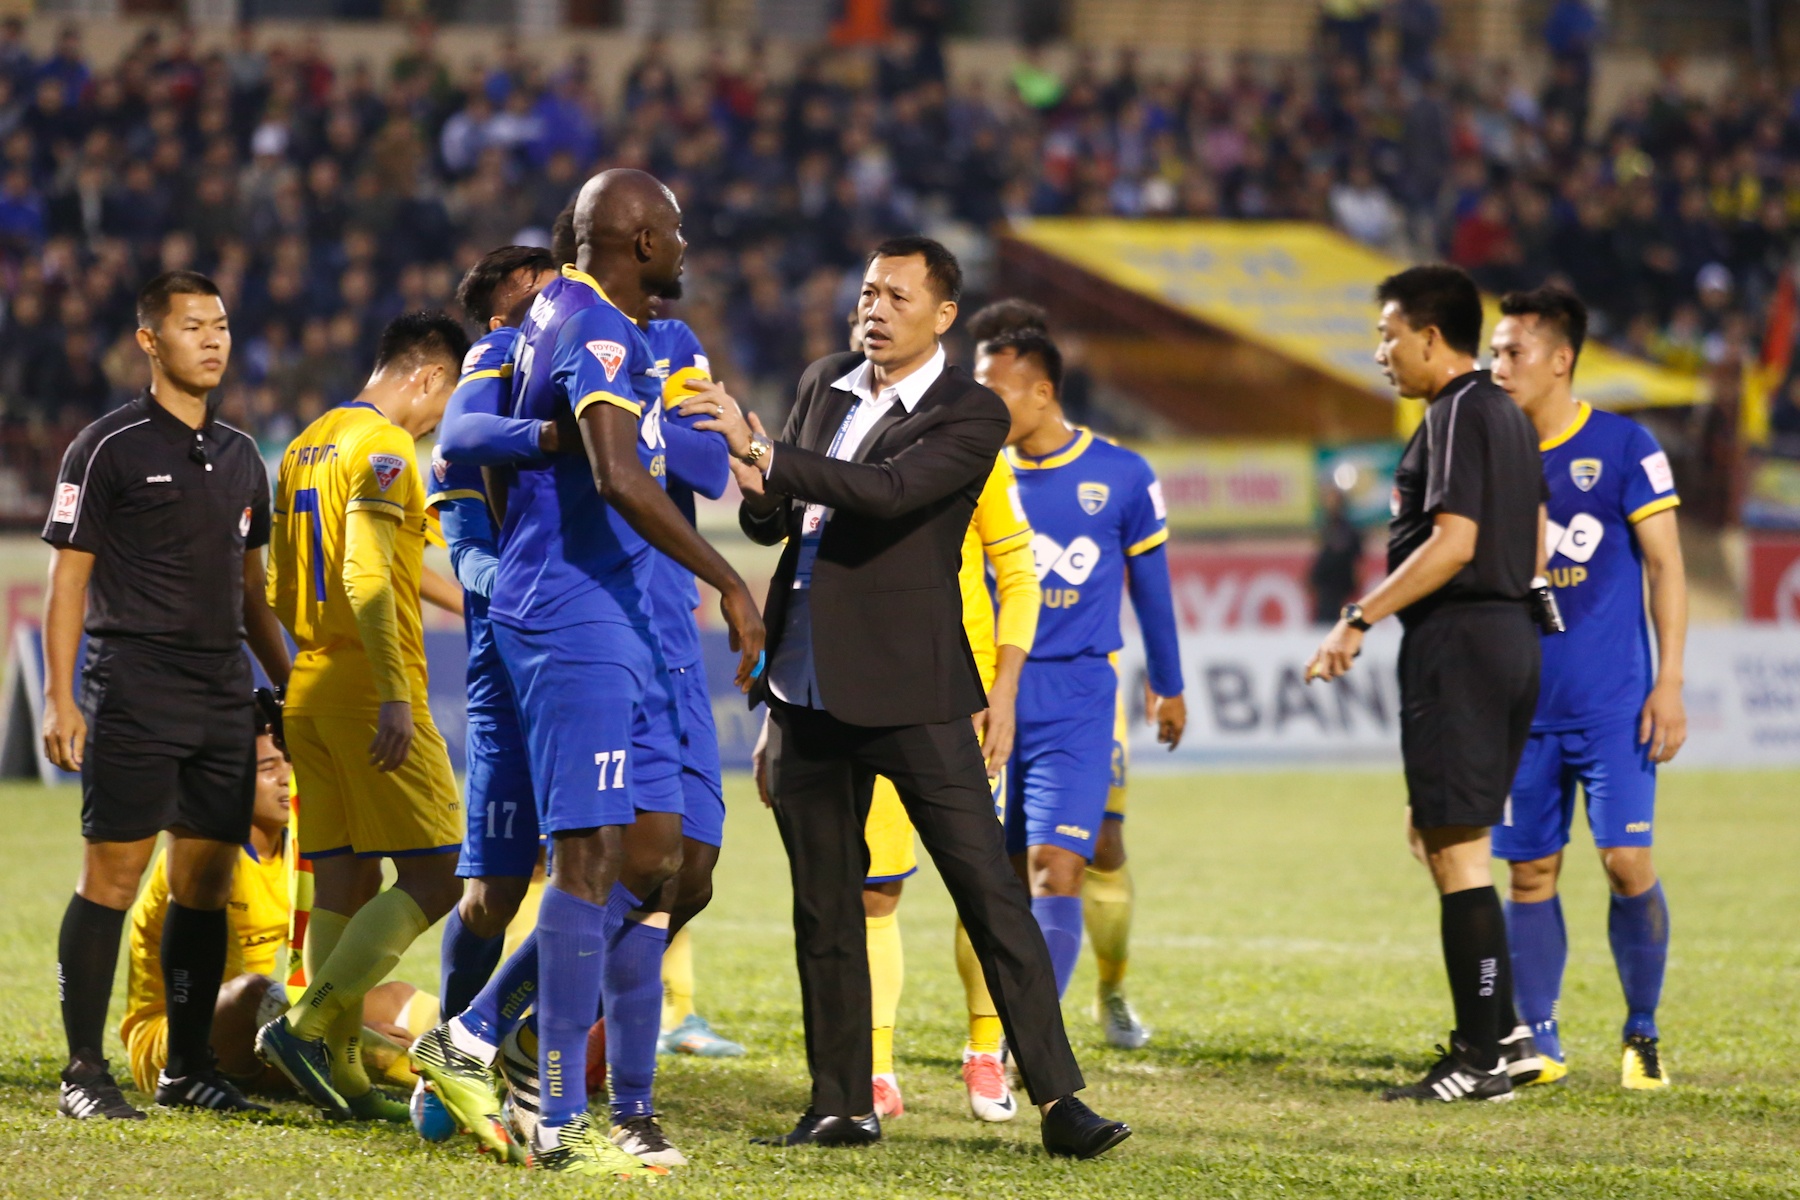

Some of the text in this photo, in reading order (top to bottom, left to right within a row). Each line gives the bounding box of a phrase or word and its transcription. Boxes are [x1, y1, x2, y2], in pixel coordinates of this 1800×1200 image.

[592, 344, 623, 356] TOYOTA
[371, 455, 403, 467] TOYOTA
[1040, 588, 1081, 610] UP
[1203, 661, 1396, 735] BAN
[594, 750, 627, 791] 77
[485, 801, 518, 839] 17
[171, 968, 193, 1004] mitre
[310, 981, 334, 1008] mitre
[1478, 957, 1499, 997] mitre
[500, 979, 535, 1020] mitre
[546, 1050, 564, 1098] mitre
